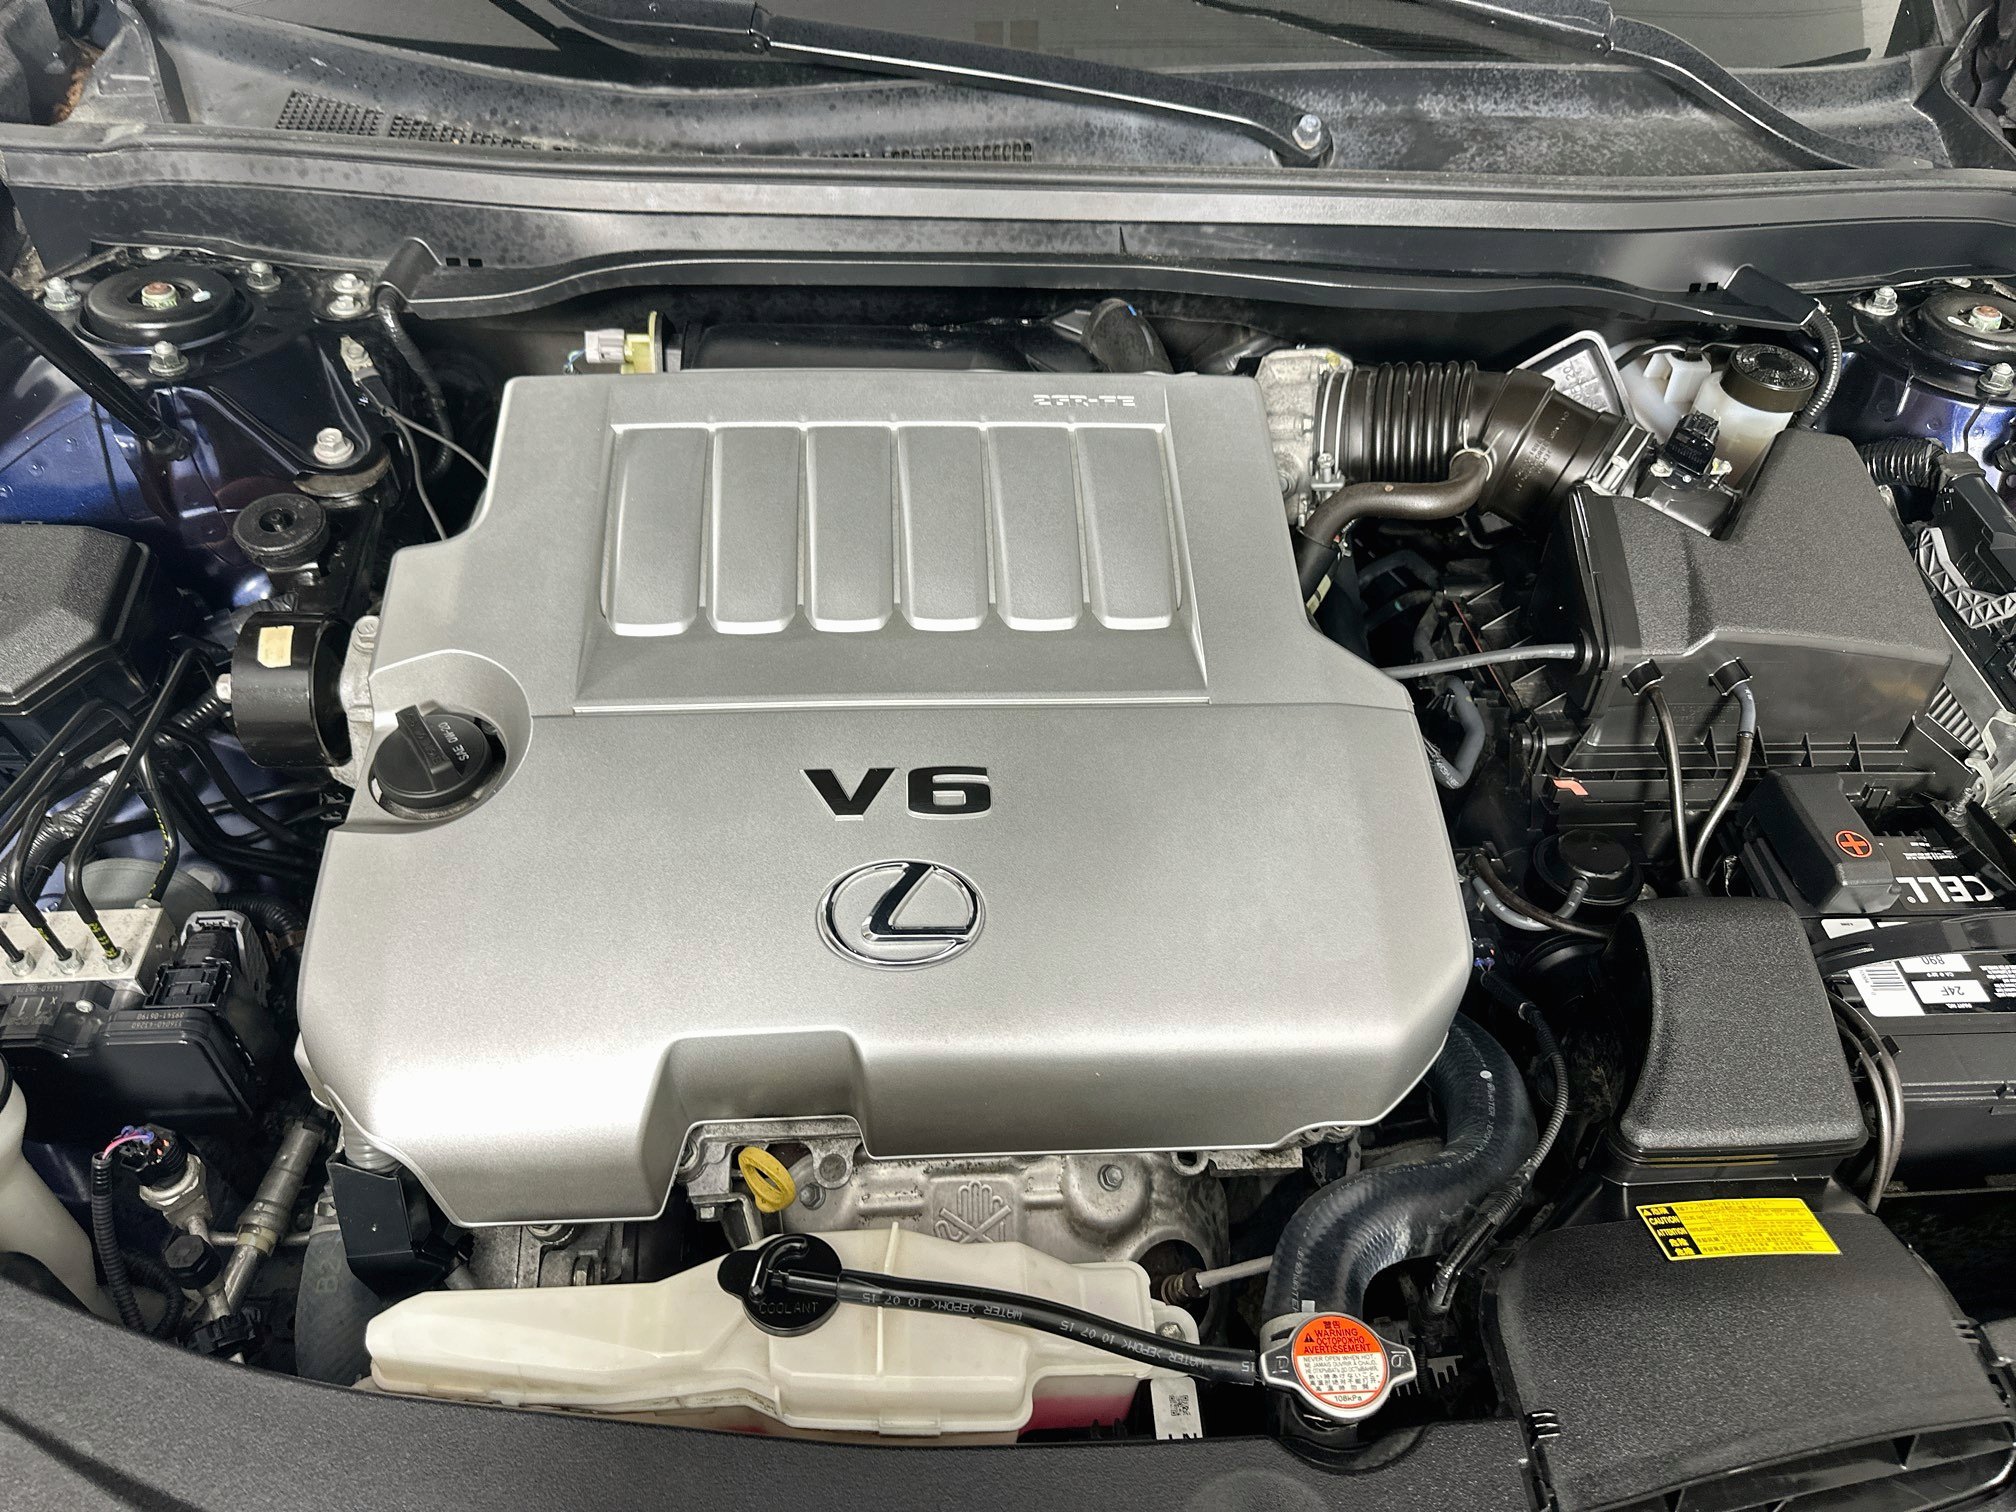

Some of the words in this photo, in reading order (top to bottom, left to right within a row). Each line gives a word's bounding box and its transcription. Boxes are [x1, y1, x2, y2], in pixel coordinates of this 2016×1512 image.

[1033, 394, 1136, 407] 2GR-FE
[452, 744, 470, 761] SAE
[800, 766, 992, 821] V6
[1941, 985, 1965, 996] 24F
[1649, 1216, 1680, 1225] CAUTION
[1657, 1227, 1688, 1237] ATTENTION
[863, 1293, 876, 1304] 15
[884, 1294, 900, 1305] 07
[758, 1302, 818, 1315] COOLANT
[983, 1305, 1023, 1320] WATER
[1059, 1320, 1075, 1332] 15
[1080, 1327, 1096, 1339] 07
[1314, 1328, 1358, 1337] WARNING
[1304, 1344, 1371, 1354] AVERTISSEMENT
[1168, 1351, 1205, 1369] WATER
[1334, 1394, 1362, 1402] 108kPa
